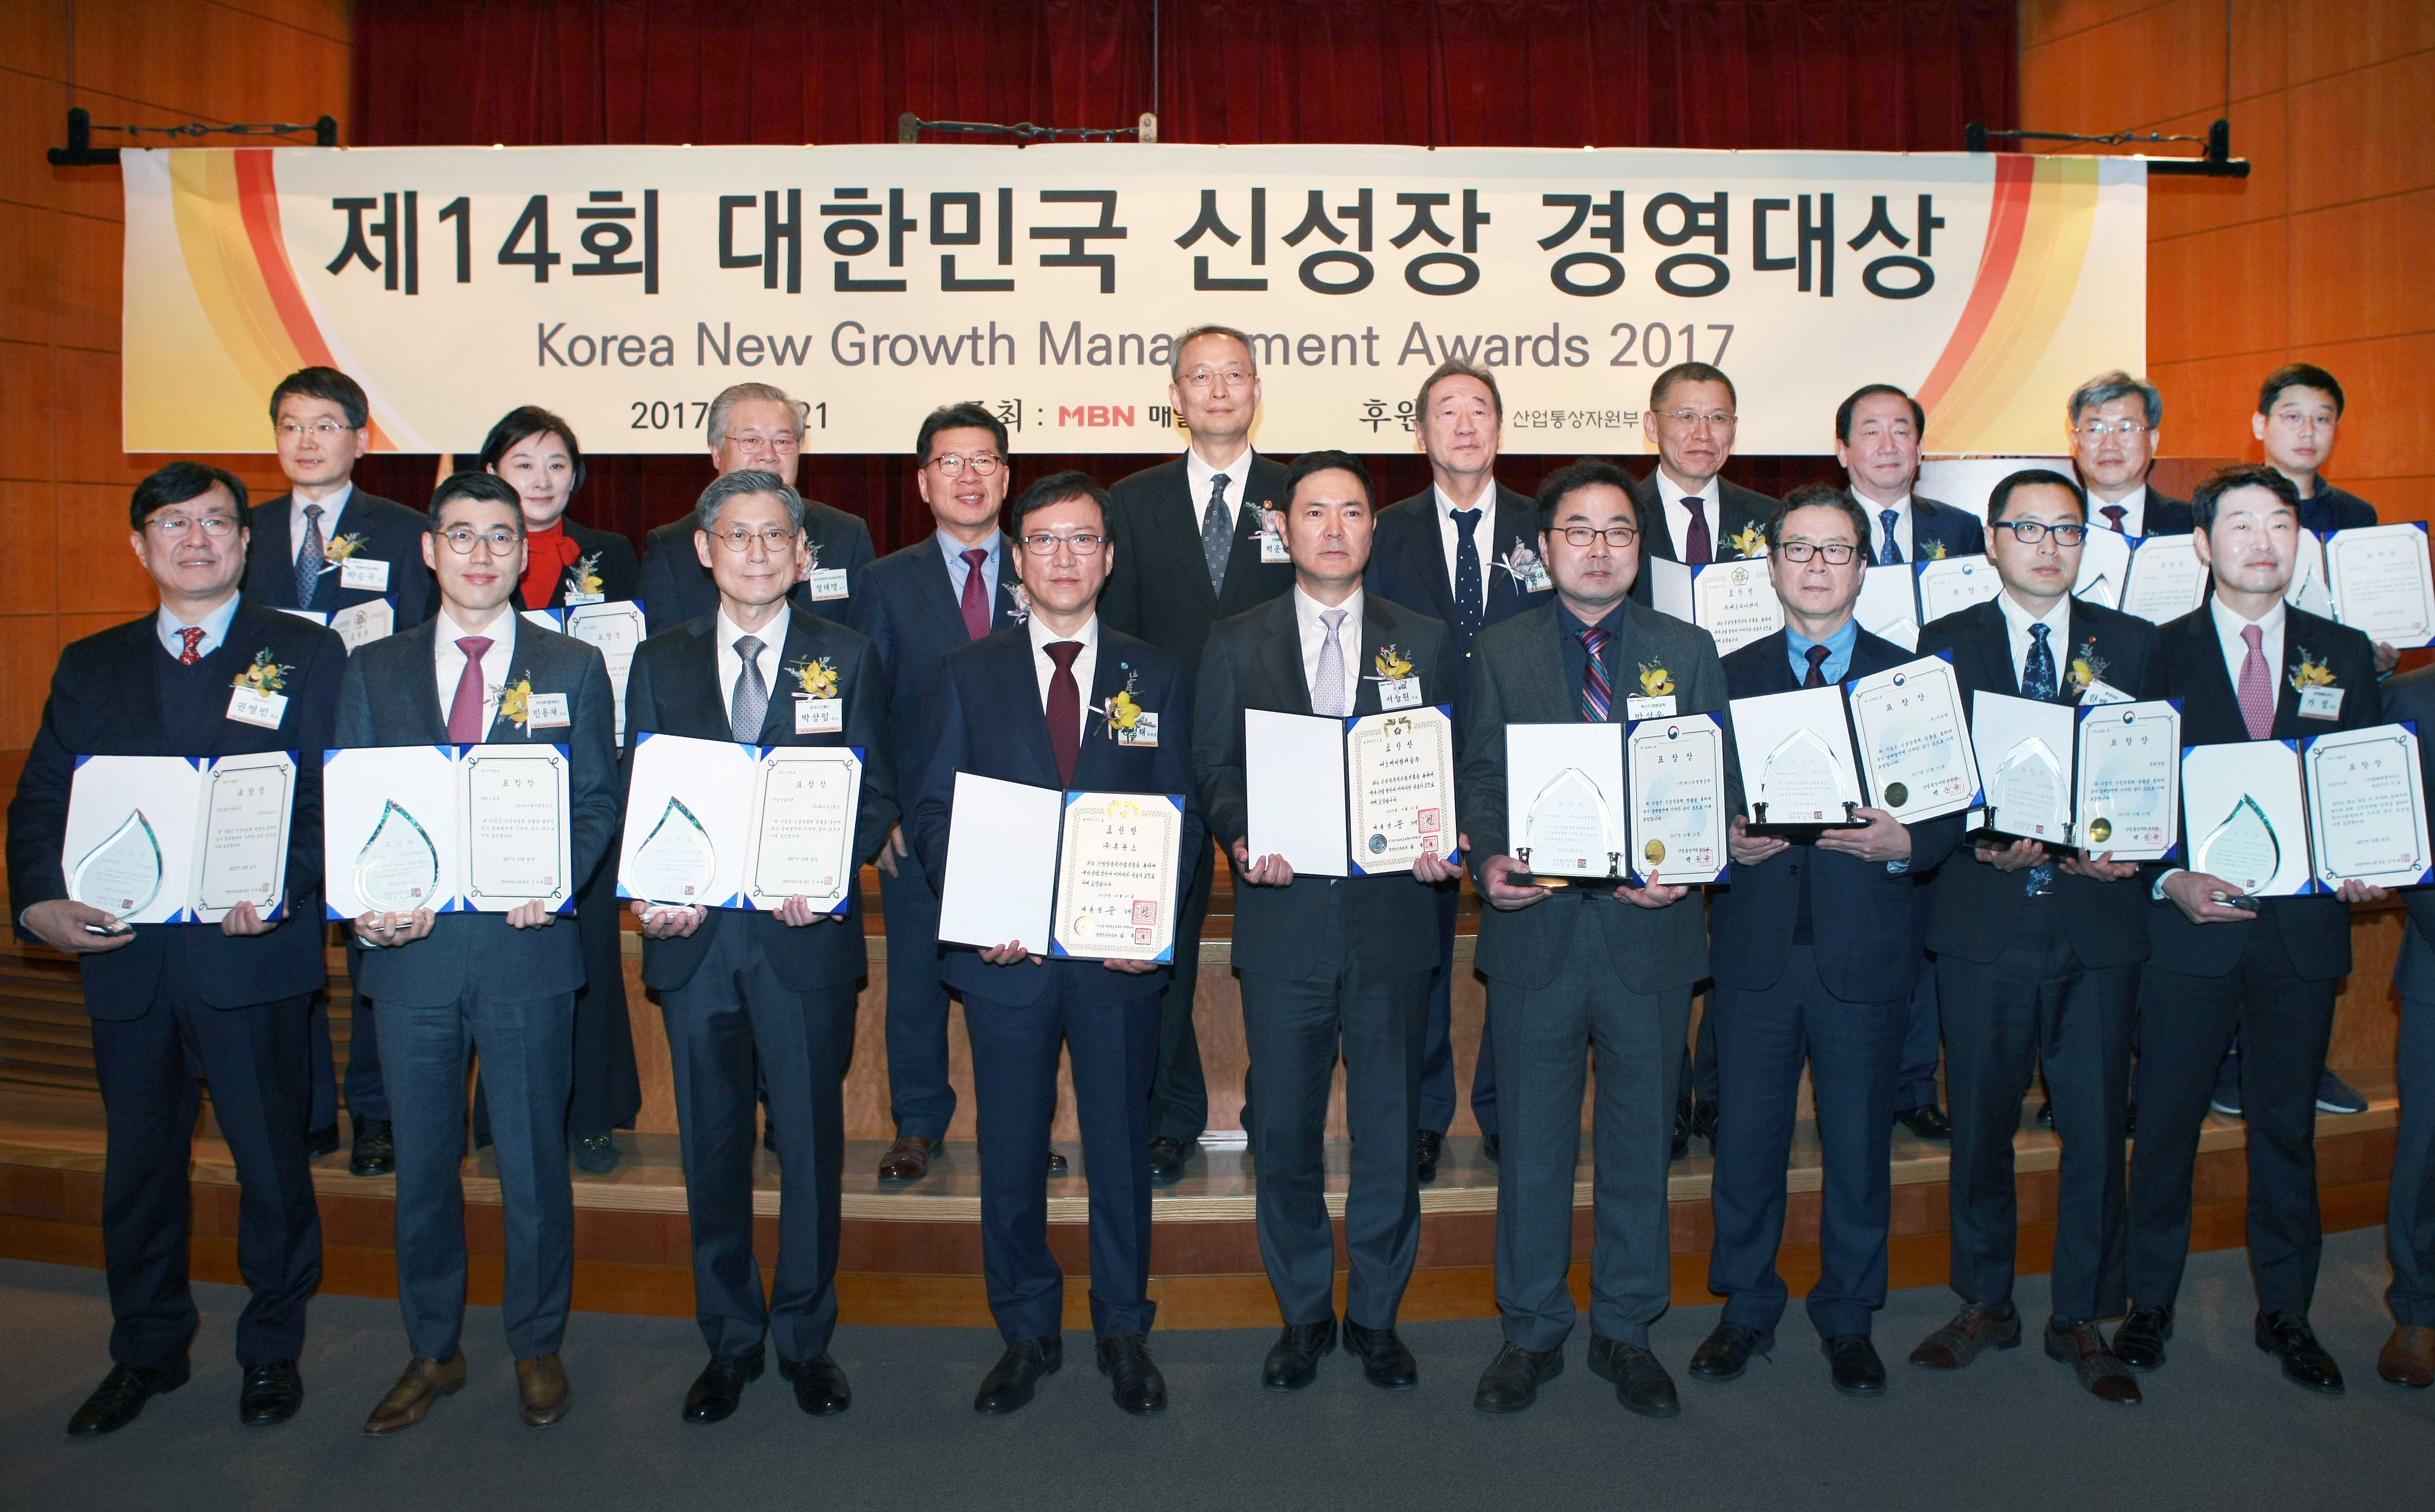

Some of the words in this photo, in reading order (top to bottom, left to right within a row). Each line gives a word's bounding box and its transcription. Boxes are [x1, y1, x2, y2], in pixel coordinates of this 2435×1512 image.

[325, 189, 659, 295] 제14회
[719, 187, 1128, 294] 대한민국
[1174, 188, 1490, 296] 신성장
[1537, 190, 1945, 300] 경영대상
[538, 323, 673, 367] Korea
[698, 322, 812, 366] New
[831, 321, 1015, 366] Growth
[1039, 321, 1380, 367] Manament
[1398, 322, 1590, 367] Awards
[1611, 322, 1734, 367] 2017
[1058, 406, 1135, 427] MBN
[1513, 410, 1639, 429] 산업통상자원부
[1886, 693, 1925, 712] 표창장
[533, 708, 556, 718] 민용재
[802, 712, 829, 723] 박상일
[1385, 740, 1413, 752] 표창장
[2110, 736, 2149, 747] 표창장
[1658, 751, 1693, 763] 표창장
[796, 780, 826, 788] 표창장
